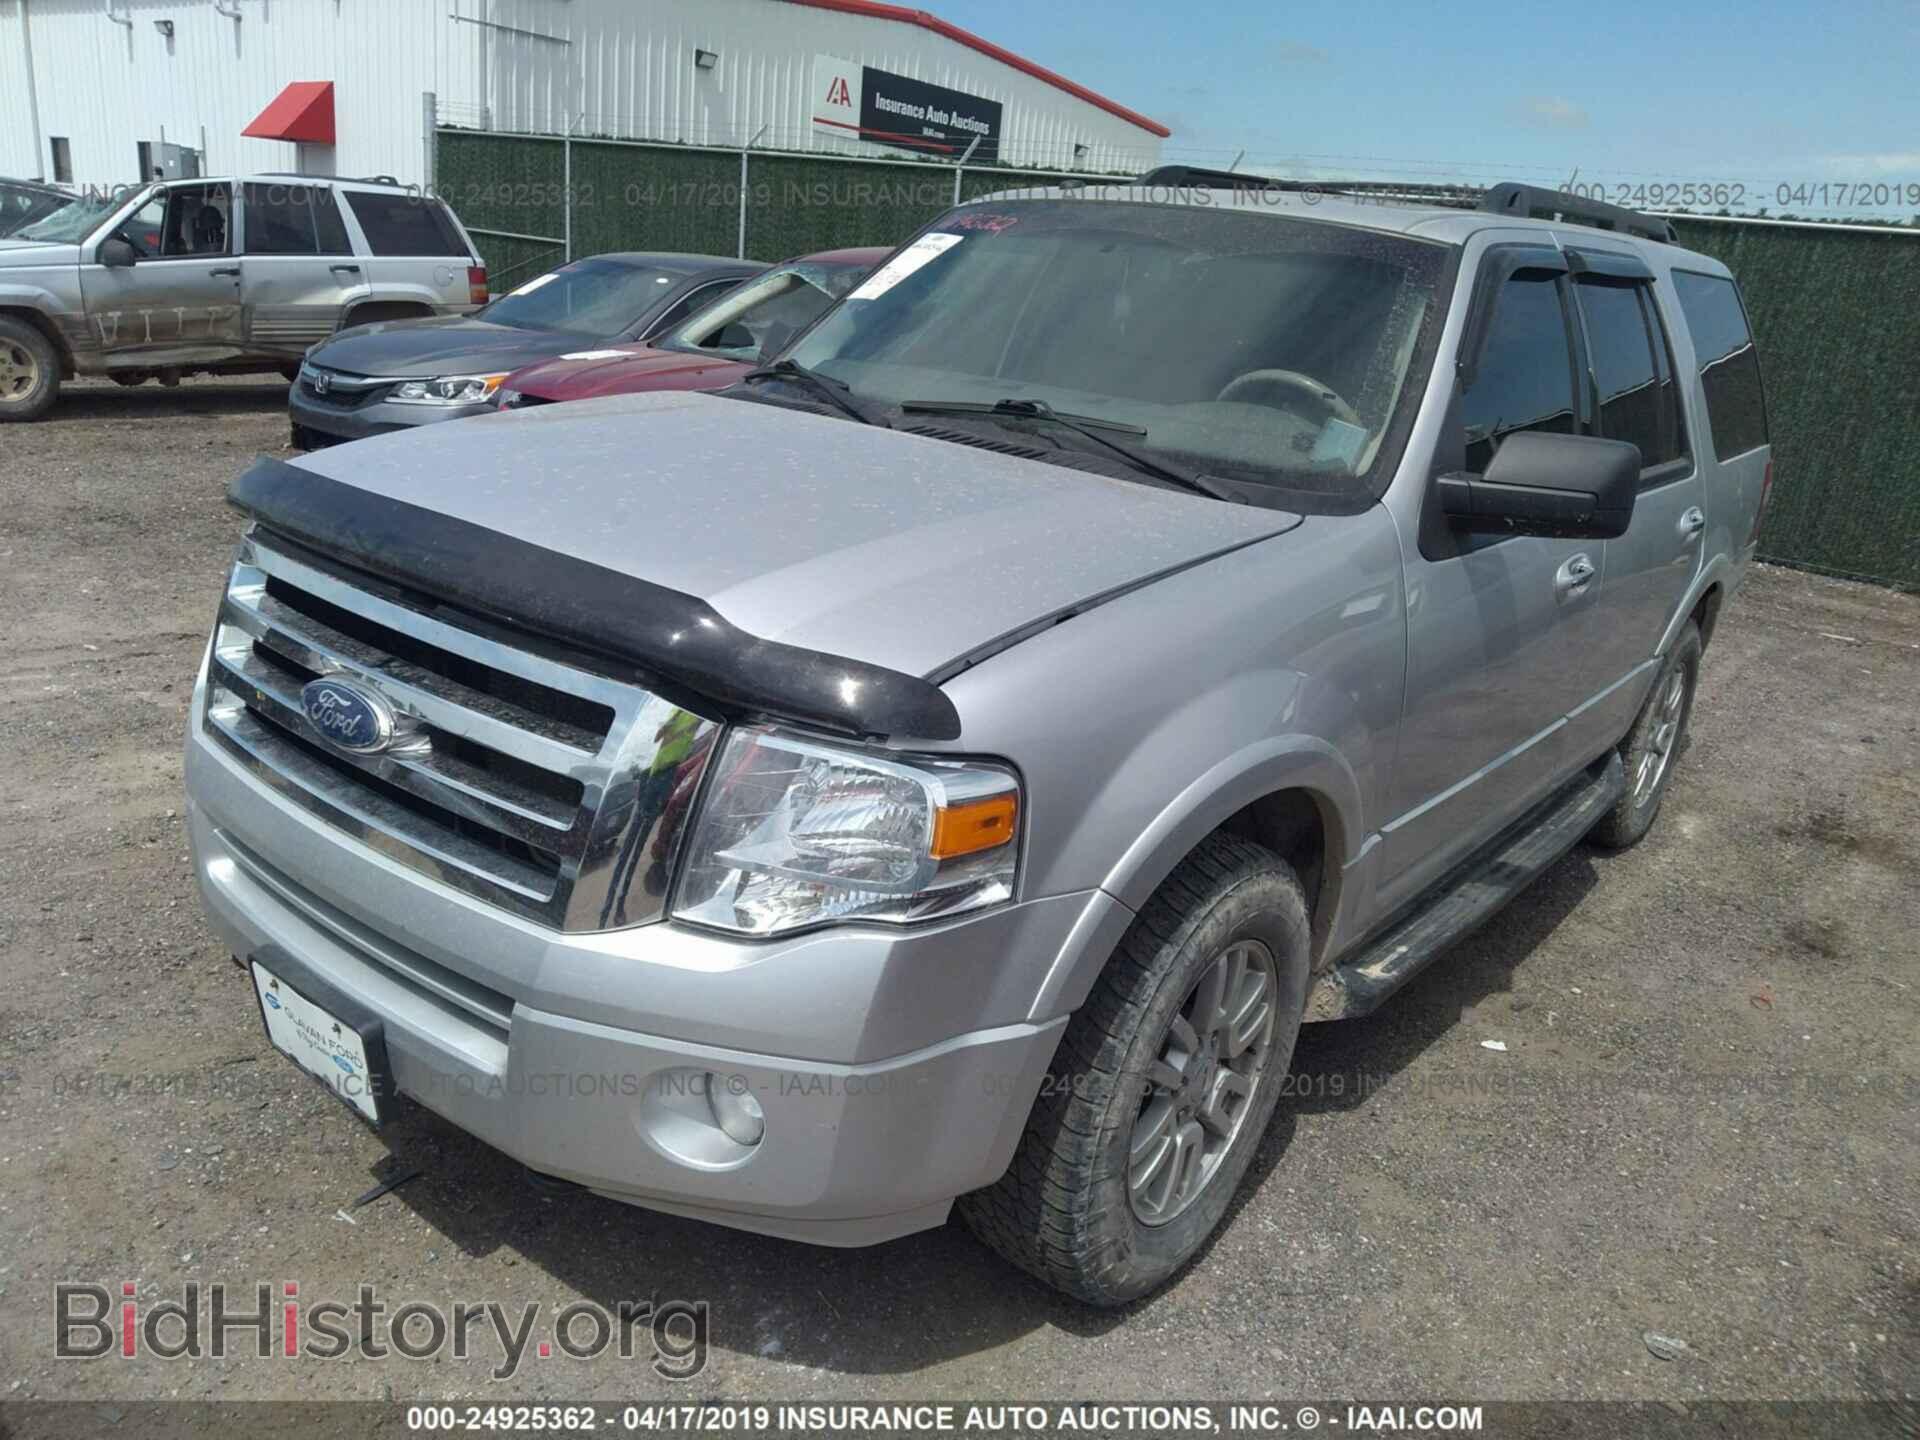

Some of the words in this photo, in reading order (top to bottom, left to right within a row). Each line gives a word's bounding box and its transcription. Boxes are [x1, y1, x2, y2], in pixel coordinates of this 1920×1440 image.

[875, 92, 924, 120] Insurance
[926, 105, 949, 125] Auto
[949, 111, 990, 135] Auctions
[311, 689, 362, 736] Ford
[328, 1039, 364, 1070] FORD
